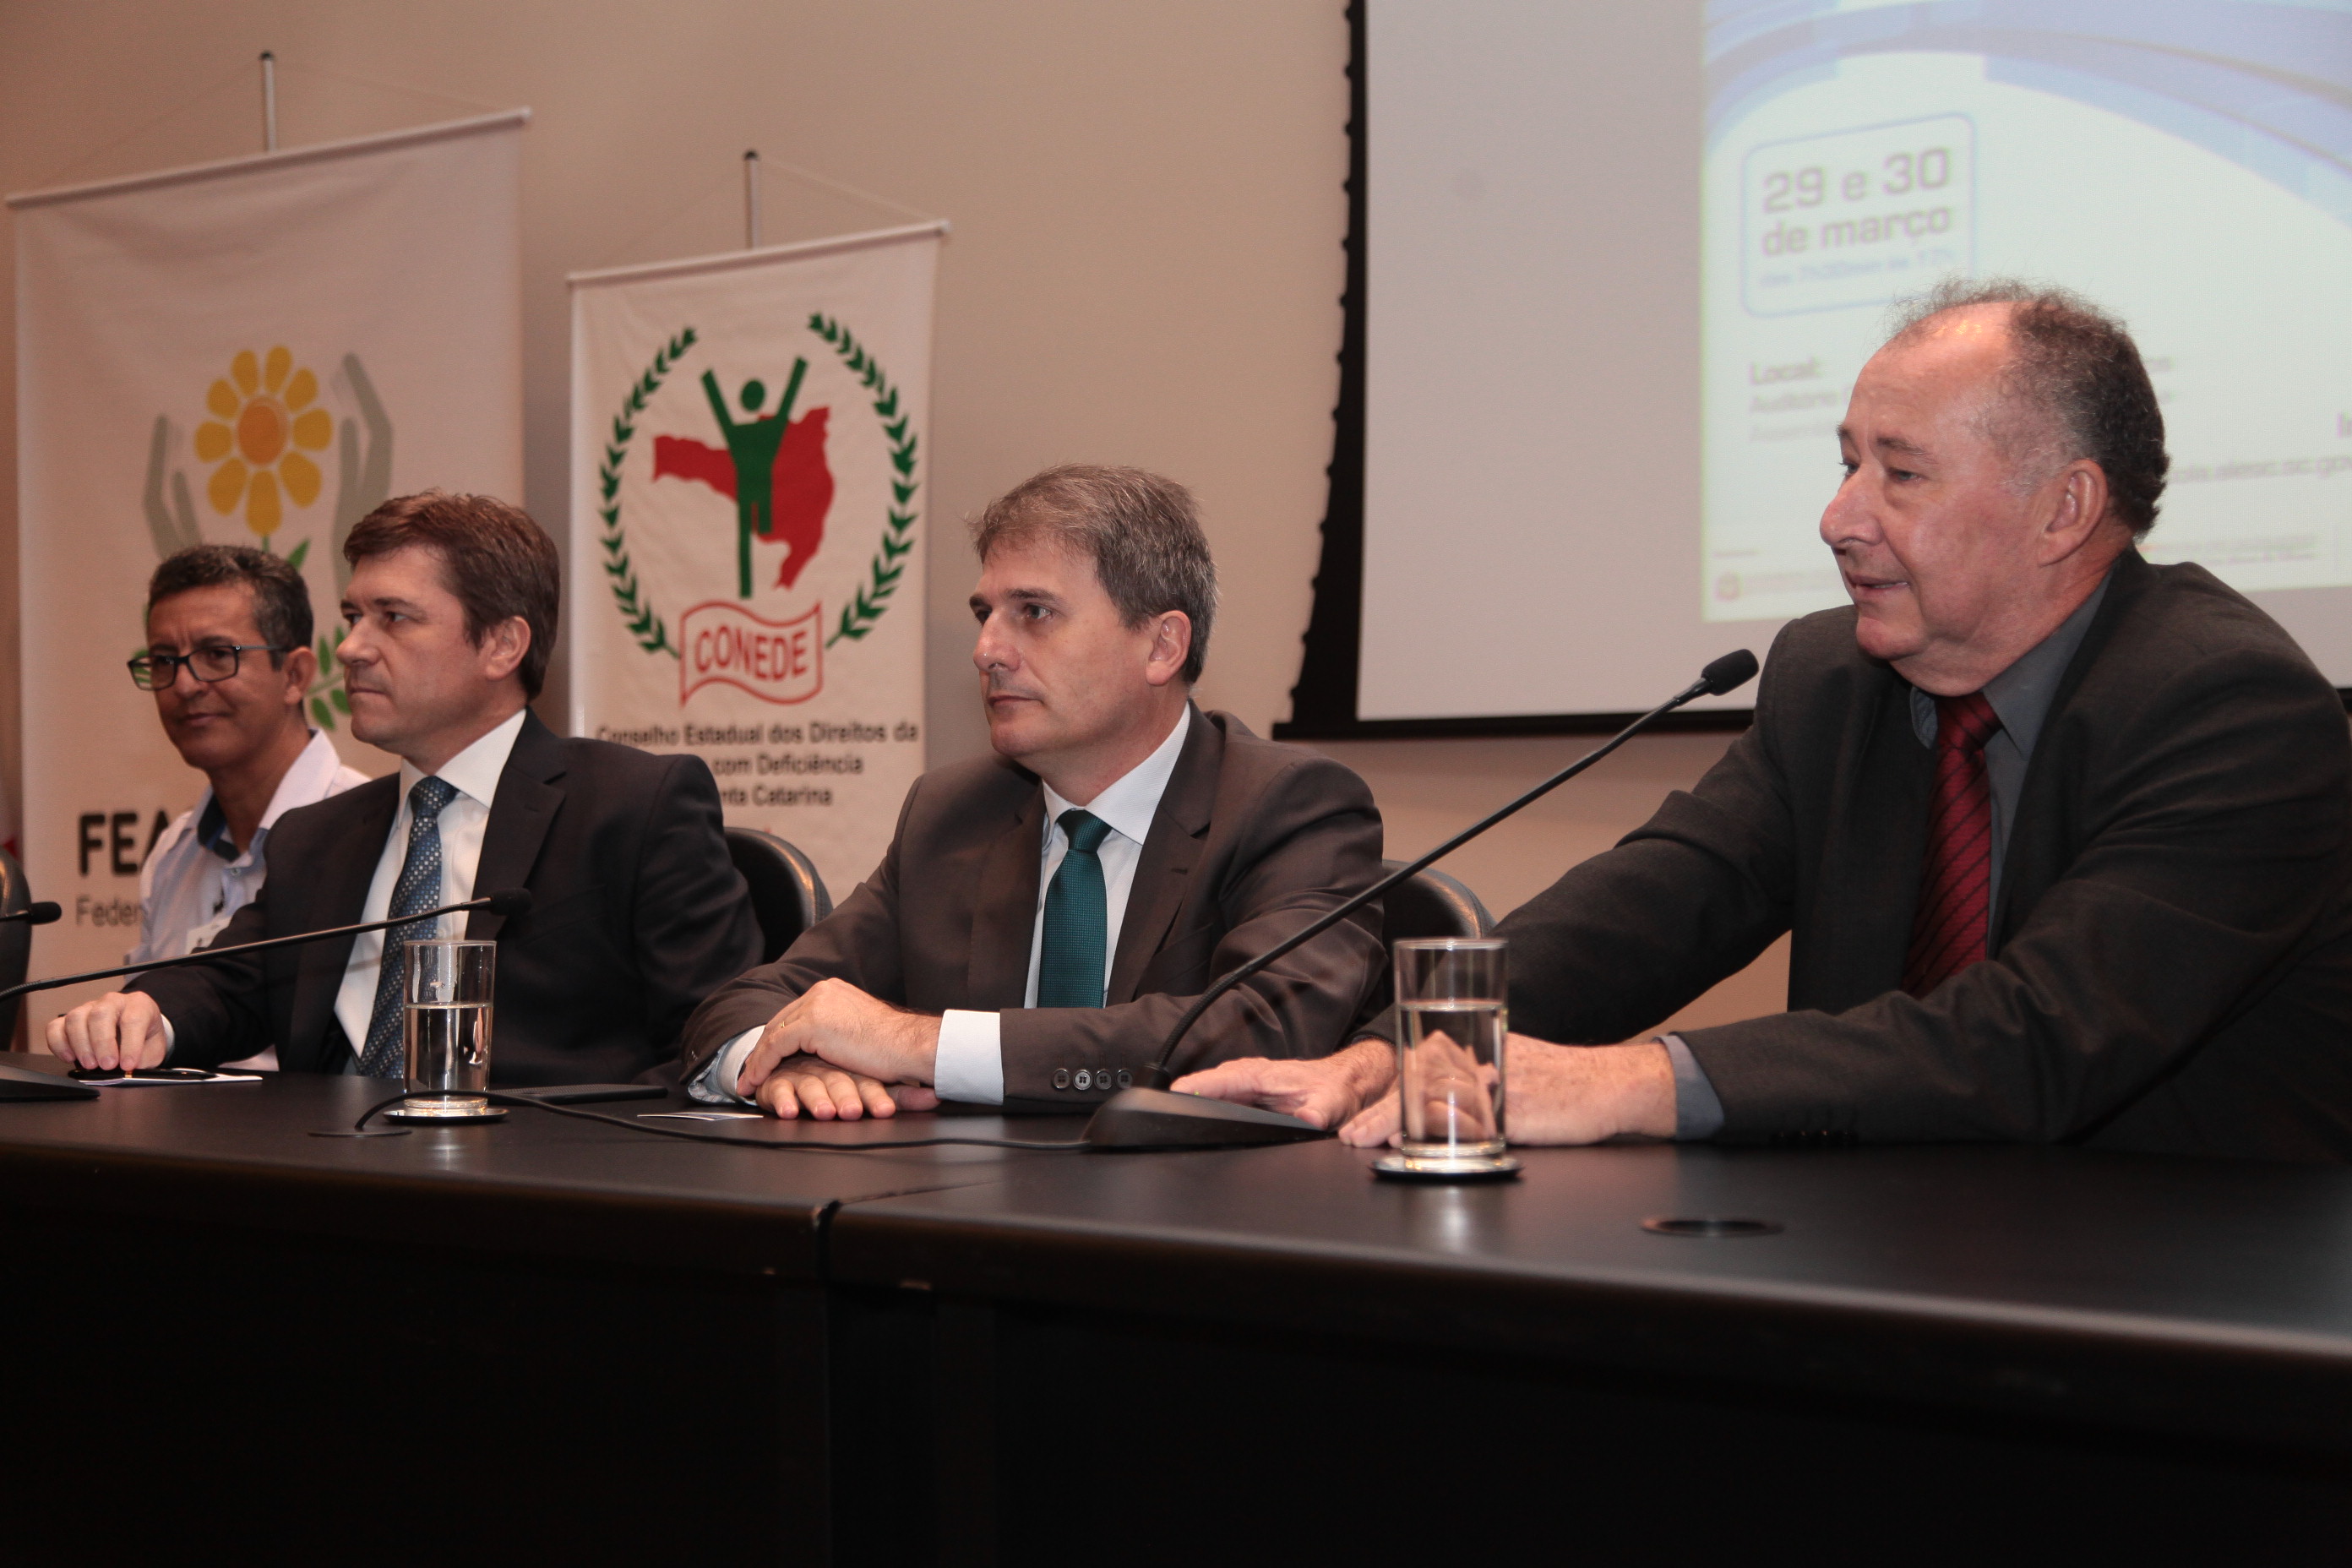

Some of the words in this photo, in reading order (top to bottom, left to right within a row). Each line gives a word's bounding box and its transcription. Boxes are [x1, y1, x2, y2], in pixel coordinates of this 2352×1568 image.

[1762, 166, 1826, 214] 29
[1841, 171, 1868, 202] e
[1881, 147, 1951, 195] 30
[1762, 218, 1809, 258] de
[1820, 206, 1952, 250] março
[694, 625, 808, 682] CONEDE
[684, 722, 764, 746] Estadual
[768, 722, 802, 744] dos
[808, 721, 886, 744] Direitos
[893, 721, 918, 743] da
[713, 759, 752, 776] com
[757, 752, 864, 776] Deficiência
[721, 787, 748, 807] nta
[752, 783, 833, 807] Catarina
[79, 808, 170, 877] FEA
[75, 894, 144, 927] Feder
